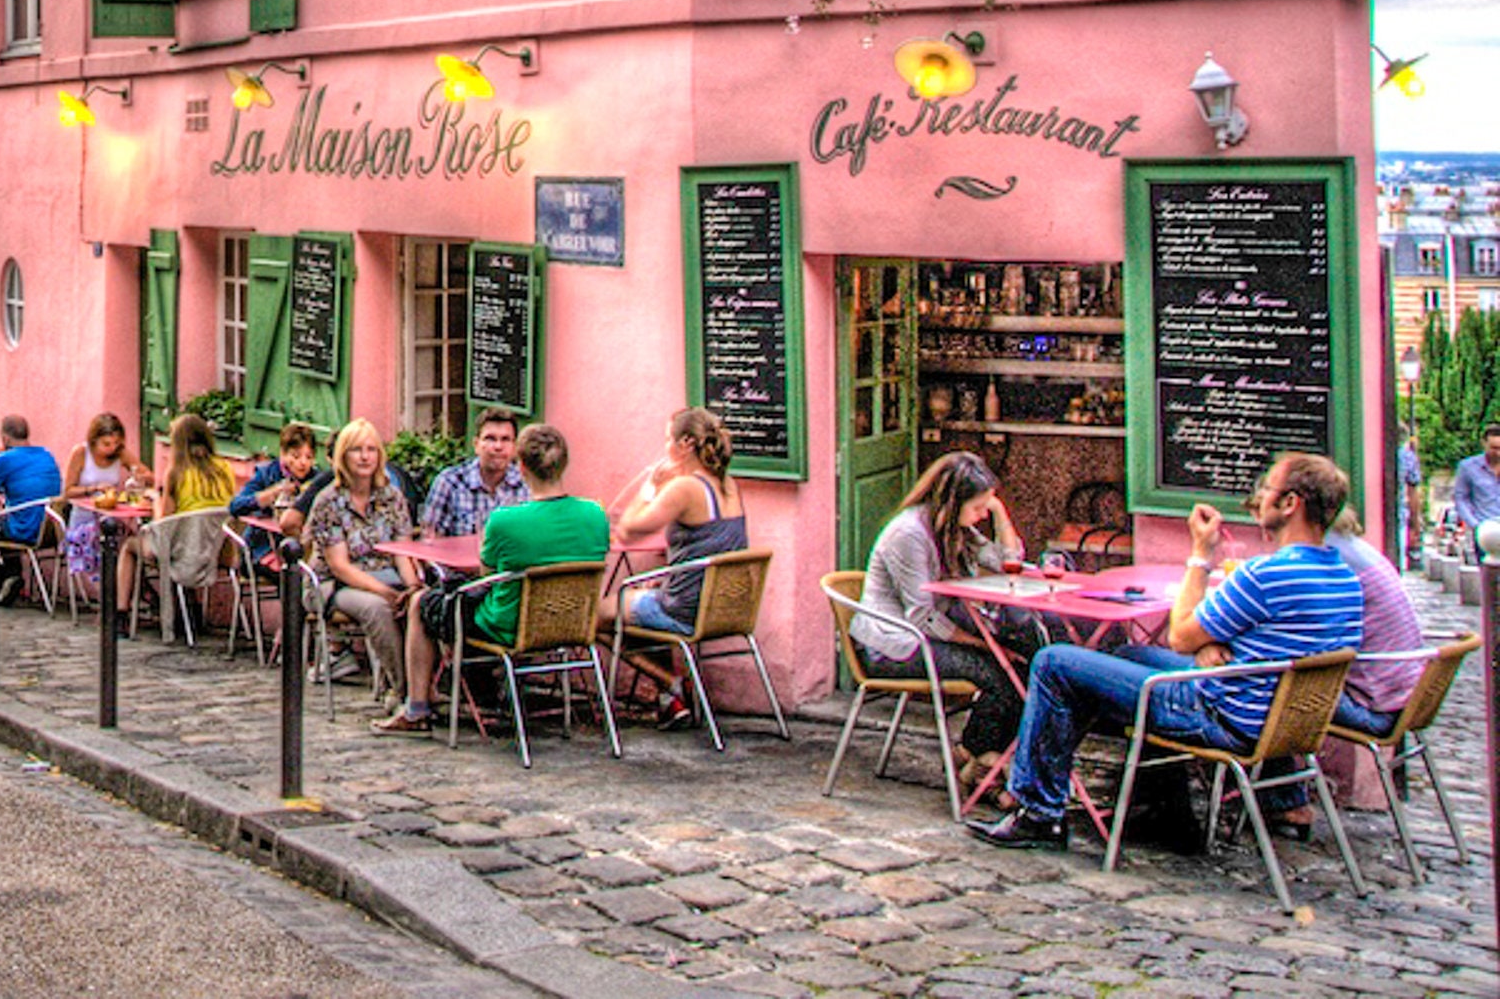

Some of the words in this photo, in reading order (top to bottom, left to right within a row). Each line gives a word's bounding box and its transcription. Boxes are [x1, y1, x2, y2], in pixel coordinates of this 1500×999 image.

[211, 104, 266, 176] La
[267, 83, 412, 179] Maison
[415, 79, 532, 179] Rose
